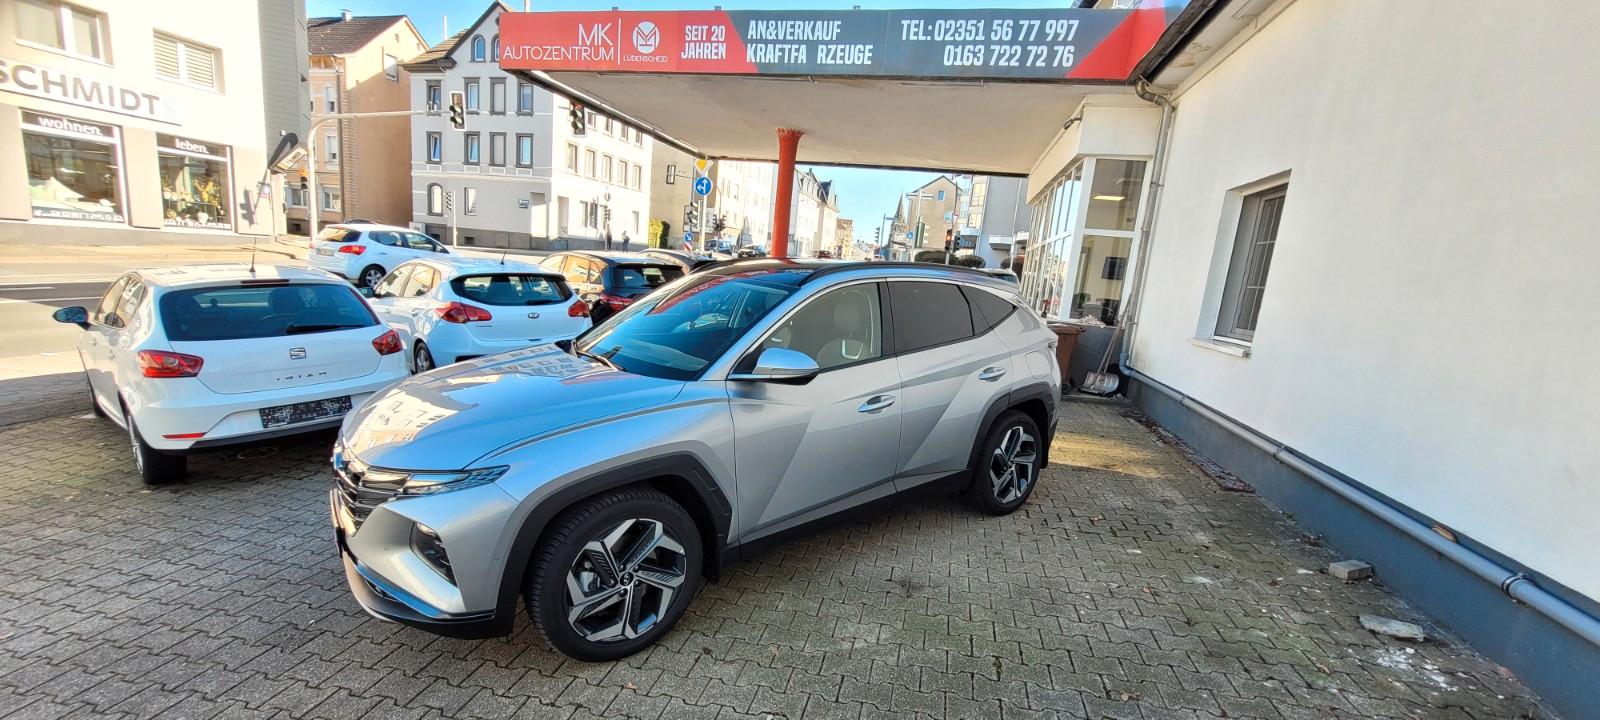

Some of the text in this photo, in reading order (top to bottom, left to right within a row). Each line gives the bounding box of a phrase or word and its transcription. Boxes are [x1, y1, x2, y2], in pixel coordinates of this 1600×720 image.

[578, 23, 614, 46] MK
[685, 25, 726, 41] SEIT 20
[747, 20, 842, 41] AN&VERKAUF
[990, 19, 1013, 41] 56
[1018, 19, 1041, 42] 77
[1045, 19, 1080, 42] 997
[502, 46, 614, 61] AUTOZENTRUM
[680, 43, 726, 60] JAHREN
[746, 43, 873, 65] KRAFTFA RZEUGE
[943, 45, 1075, 67] 0163 722 72 76
[38, 115, 104, 137] wohnen.
[175, 138, 209, 154] leben.
